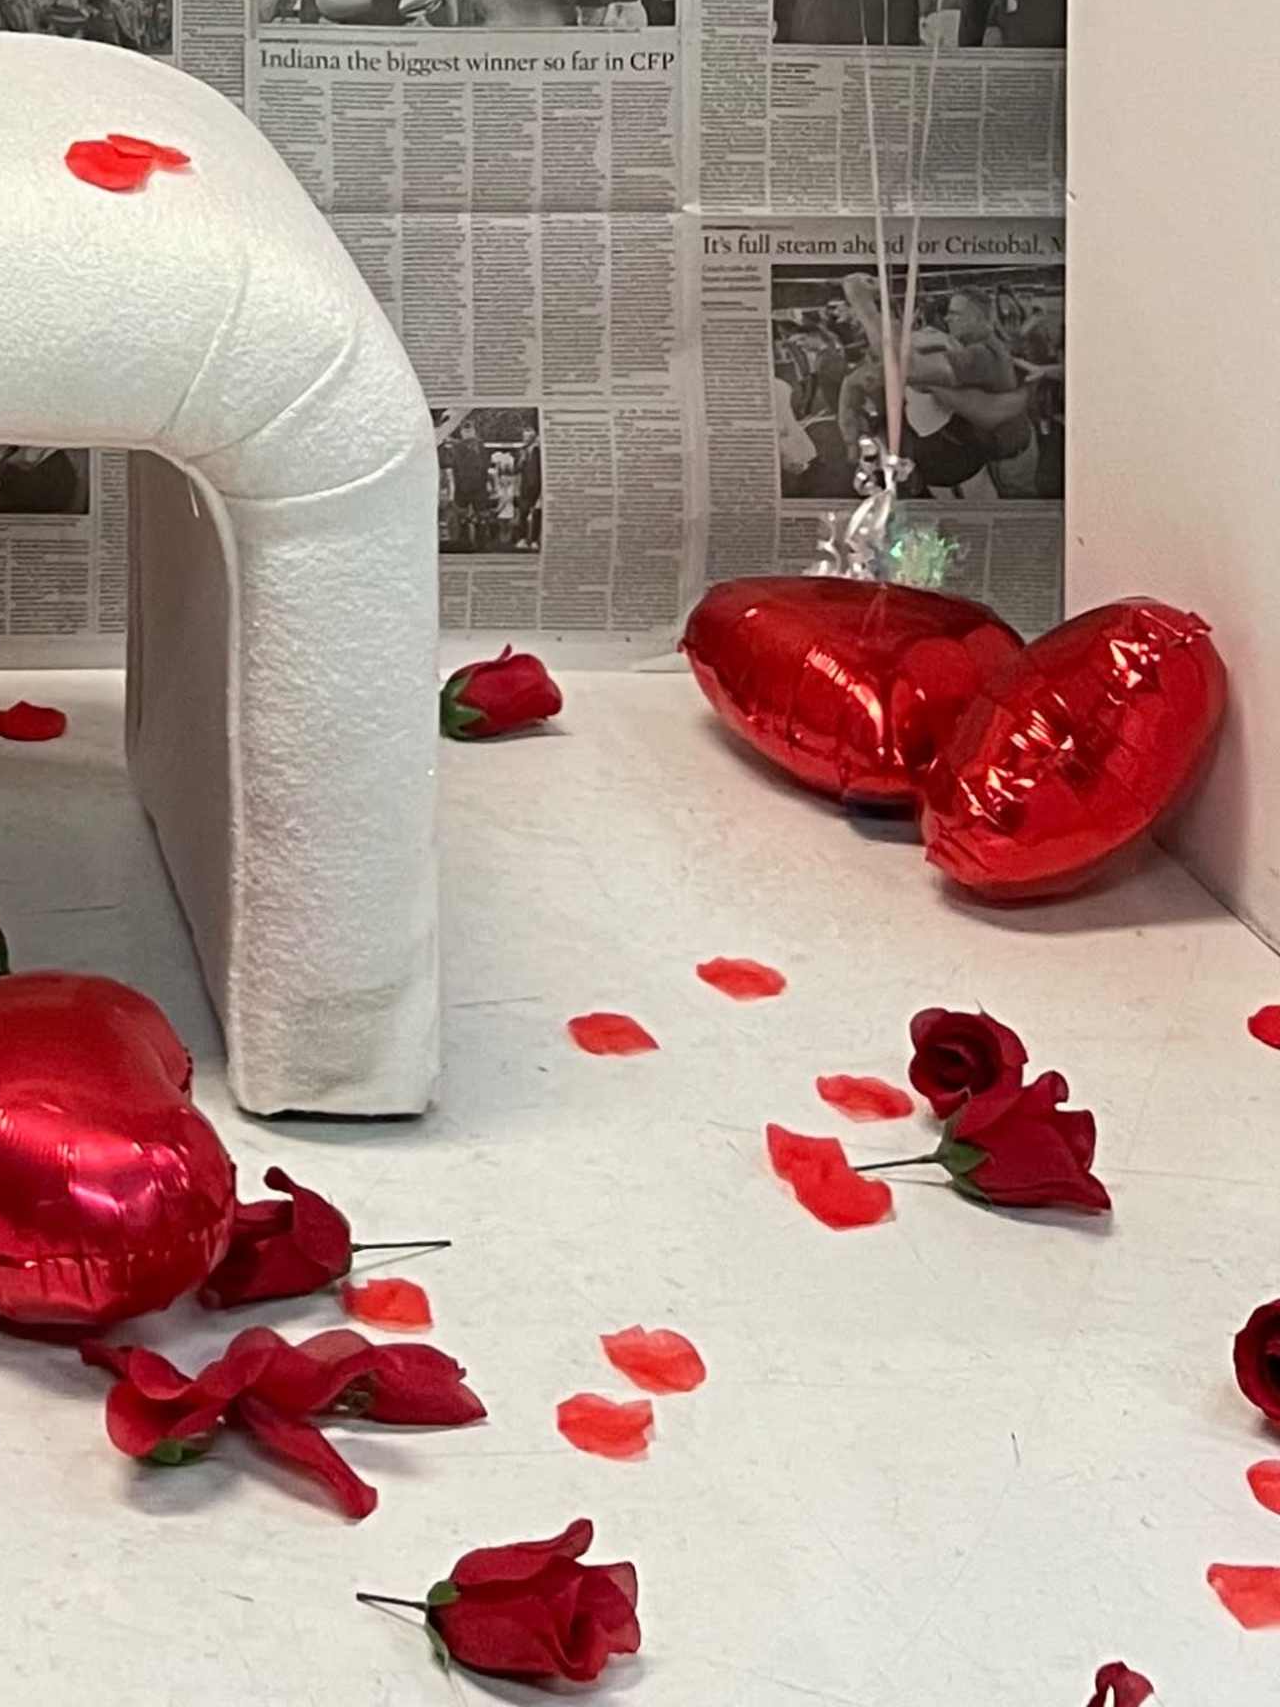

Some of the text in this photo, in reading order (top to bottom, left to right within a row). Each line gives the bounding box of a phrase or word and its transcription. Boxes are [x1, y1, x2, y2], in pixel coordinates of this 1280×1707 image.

[260, 48, 674, 77] Indiana the biggest winner so far in CFP
